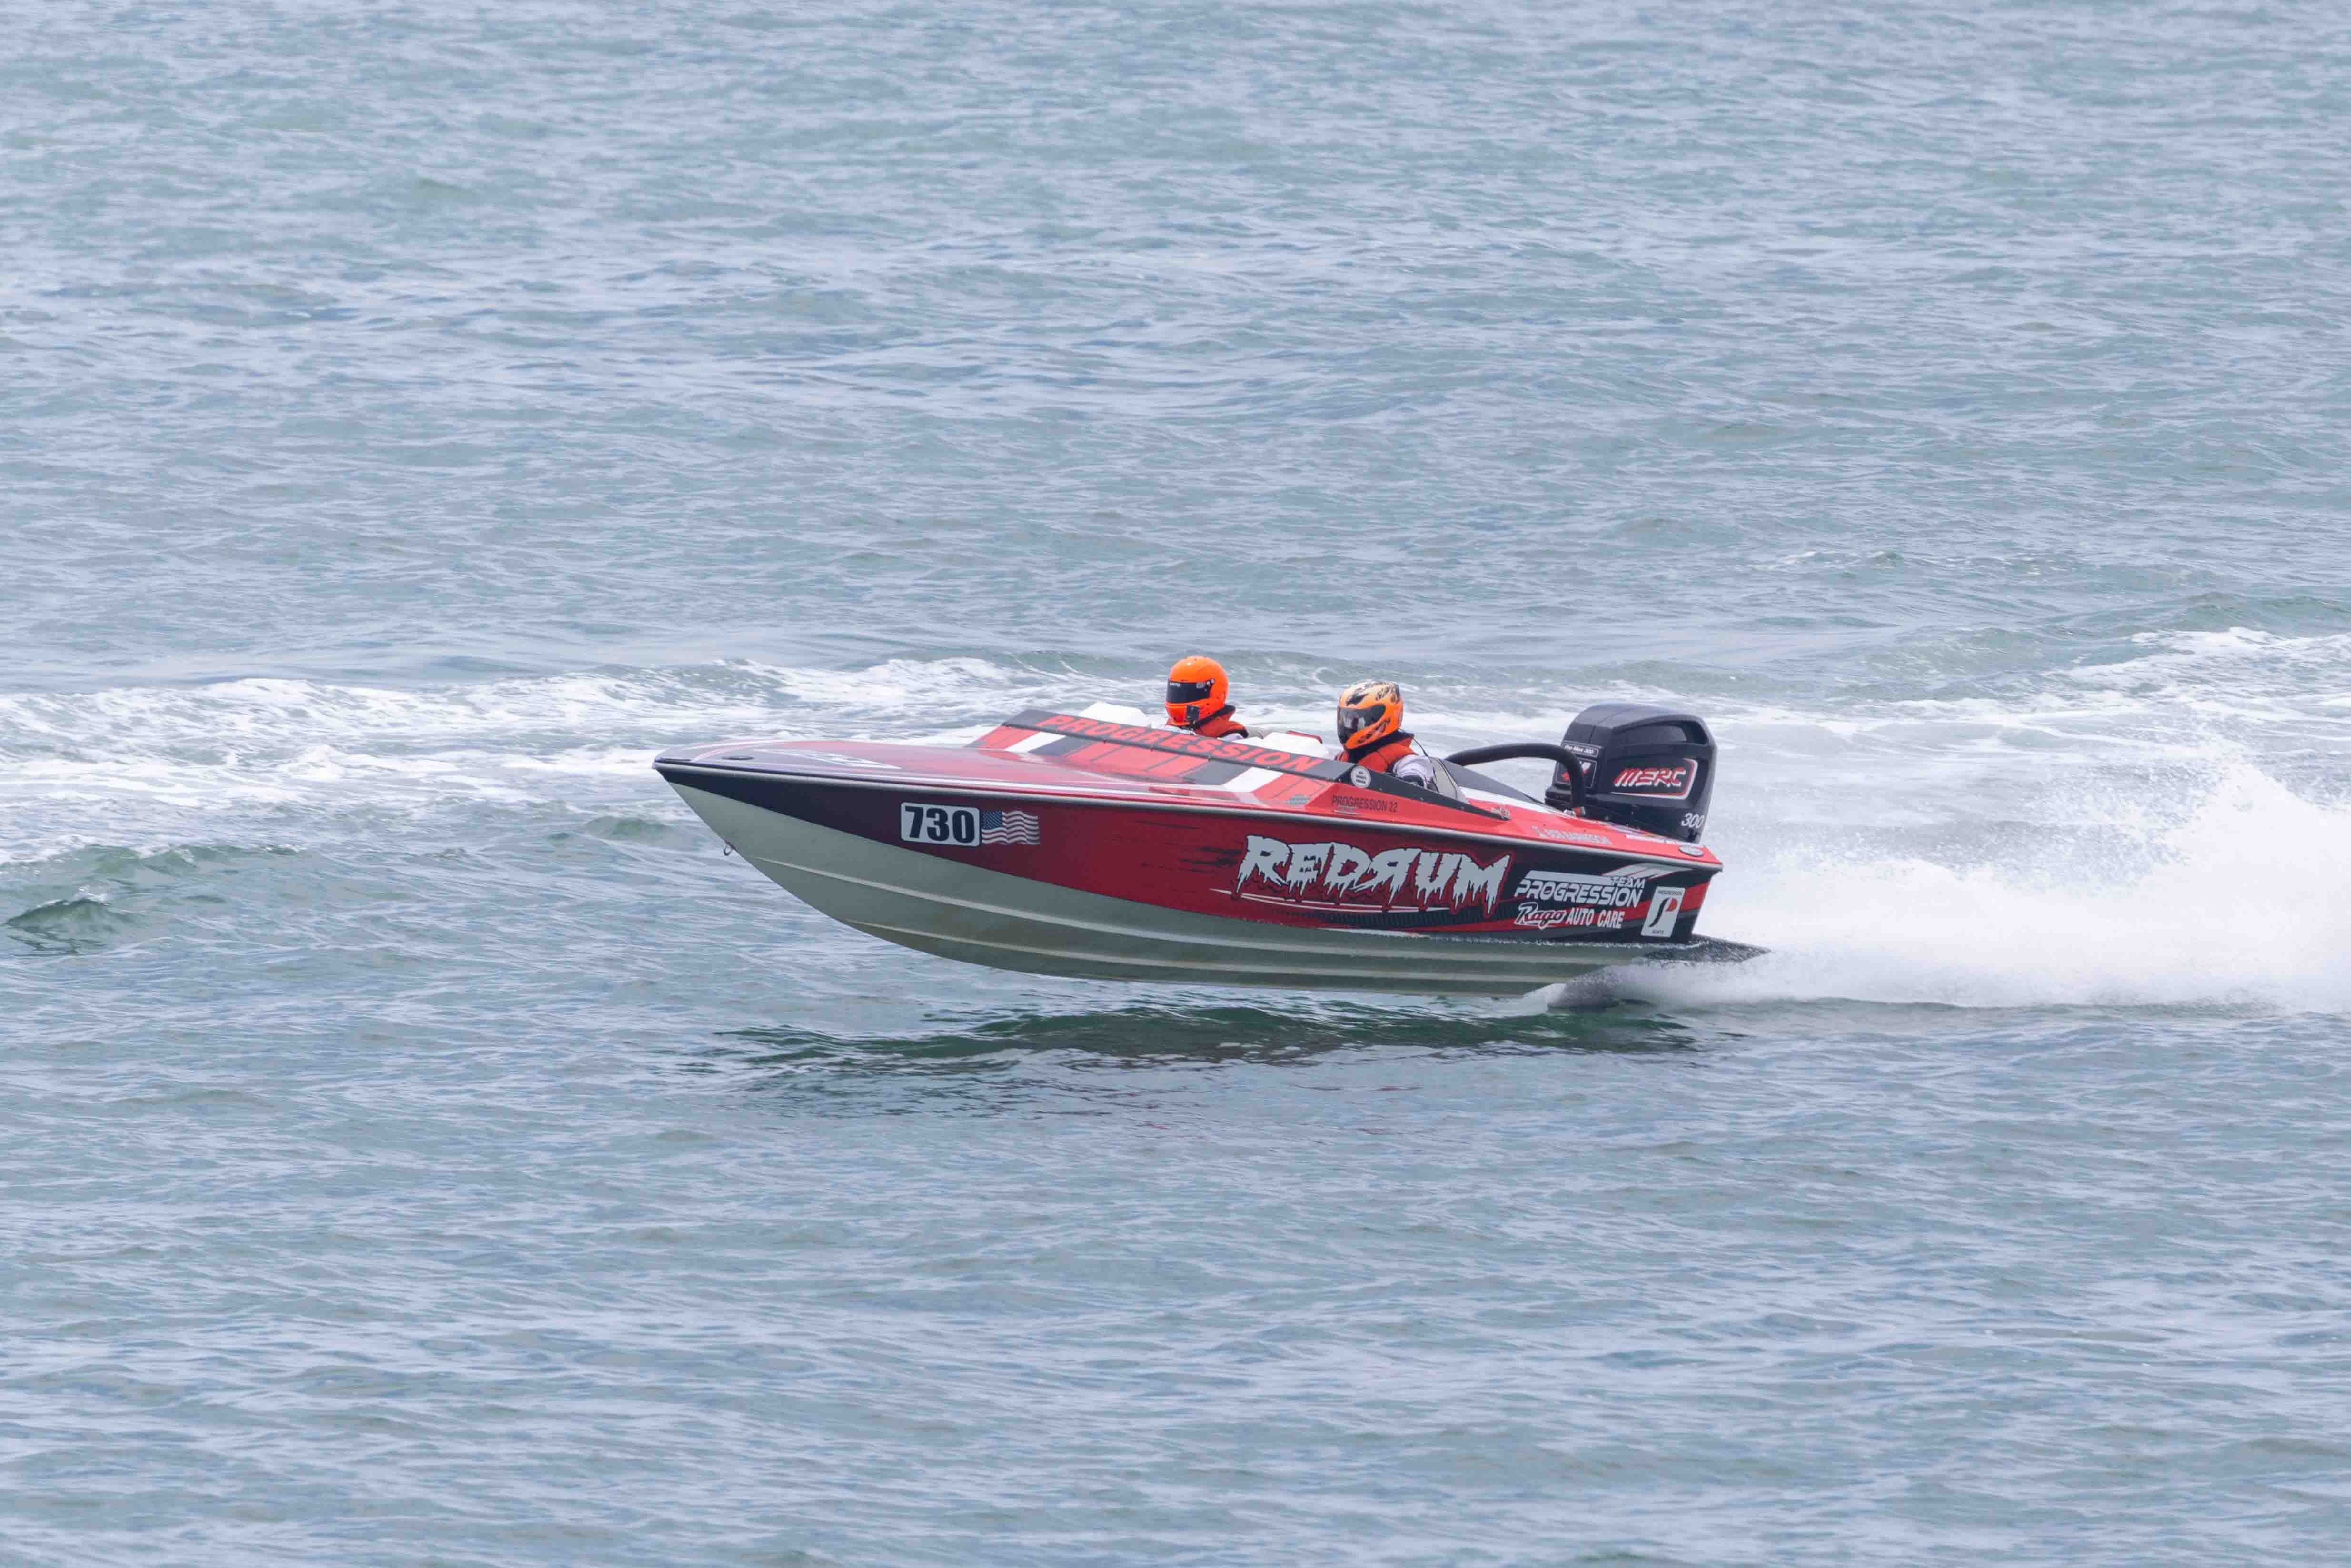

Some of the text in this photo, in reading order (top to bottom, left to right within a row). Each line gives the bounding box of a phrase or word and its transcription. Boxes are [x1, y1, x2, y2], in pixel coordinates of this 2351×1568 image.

[1035, 715, 1322, 772] PROGRESSION
[1614, 767, 1686, 787] MERC
[1331, 795, 1398, 812] PROGRESSION 22
[905, 806, 975, 843] 730
[1681, 813, 1704, 829] 300
[1611, 876, 1645, 888] TEAM
[1514, 879, 1643, 907] PROGRESSION
[1566, 908, 1594, 926] AUTO
[1597, 910, 1625, 928] CARE
